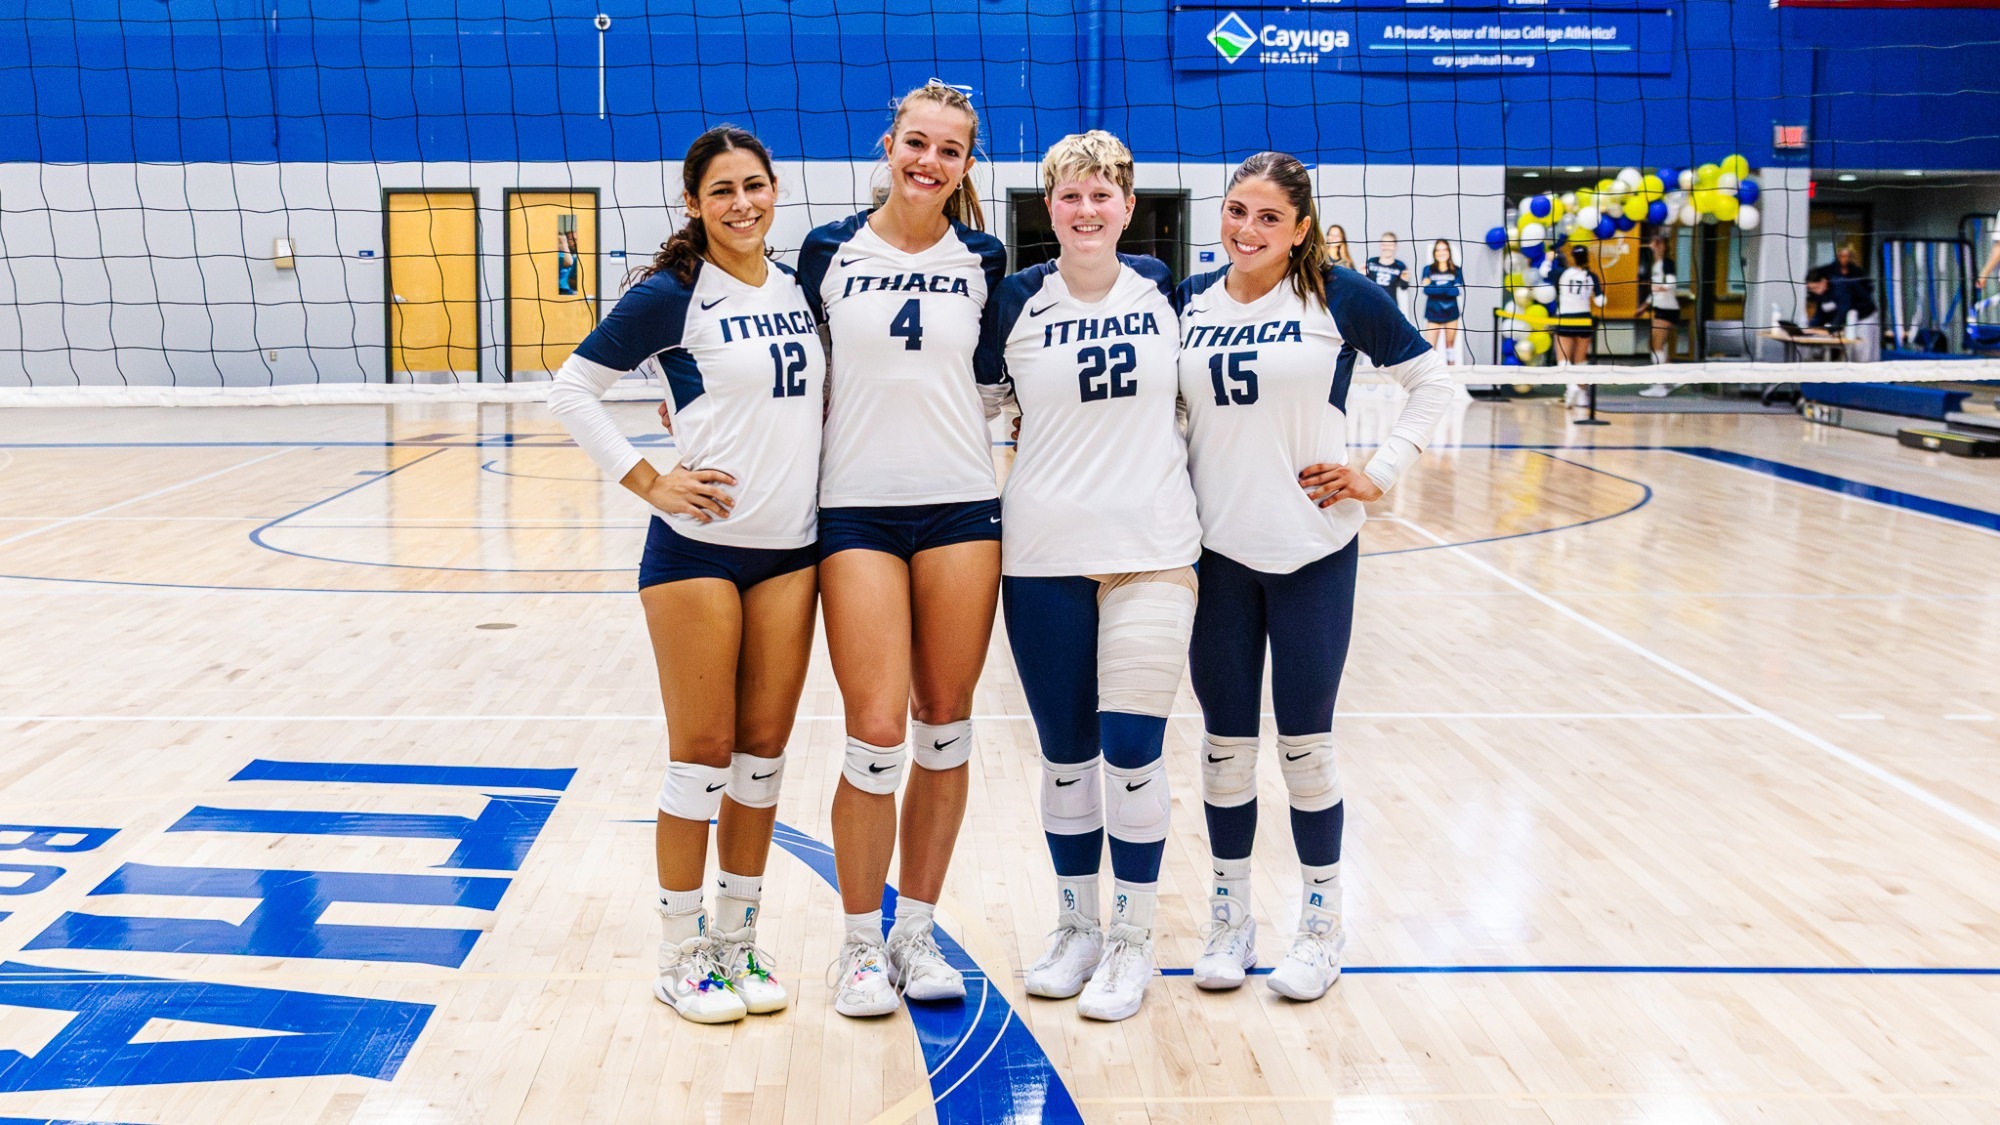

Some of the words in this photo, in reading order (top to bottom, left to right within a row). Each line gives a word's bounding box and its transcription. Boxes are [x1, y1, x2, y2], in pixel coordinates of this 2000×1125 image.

[1260, 25, 1349, 52] Cayuga
[1383, 26, 1392, 39] A
[1394, 25, 1428, 39] Proud
[1429, 26, 1474, 41] Sponsor
[1475, 26, 1487, 39] of
[1488, 26, 1520, 39] Ithaca
[1522, 26, 1563, 42] College
[1260, 52, 1318, 64] HEALTH
[1432, 54, 1535, 67] cayugahealth.org
[842, 273, 970, 298] ITHACA
[719, 310, 819, 343] ITHACA
[889, 298, 923, 350] 4
[1043, 312, 1160, 348] ITHACA
[1183, 320, 1303, 350] ITHACA
[769, 341, 807, 398] 12
[1077, 342, 1138, 403] 22
[1208, 350, 1259, 406] 15
[0, 759, 578, 1125] ITHA
